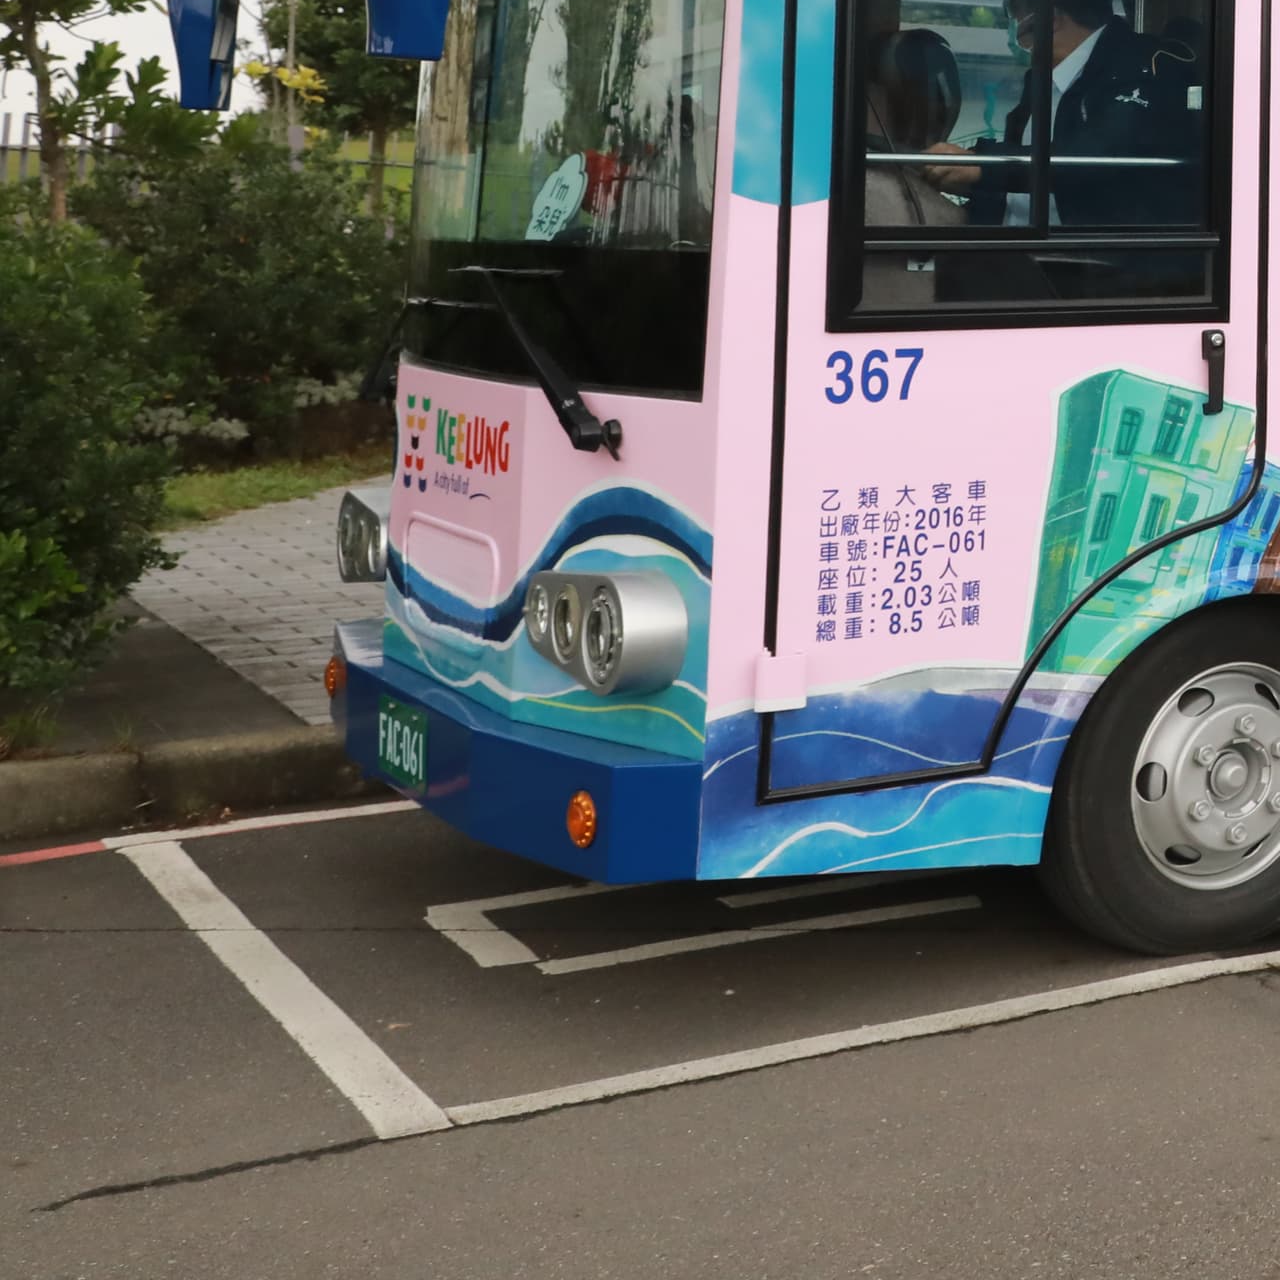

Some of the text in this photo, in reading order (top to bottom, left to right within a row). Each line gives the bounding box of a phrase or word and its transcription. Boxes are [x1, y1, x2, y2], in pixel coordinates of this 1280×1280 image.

[550, 177, 569, 201] I'm
[825, 348, 924, 404] 367
[435, 408, 509, 476] KEELUNG
[821, 480, 986, 512] 乙類大客車
[379, 711, 423, 781] FAC-061
